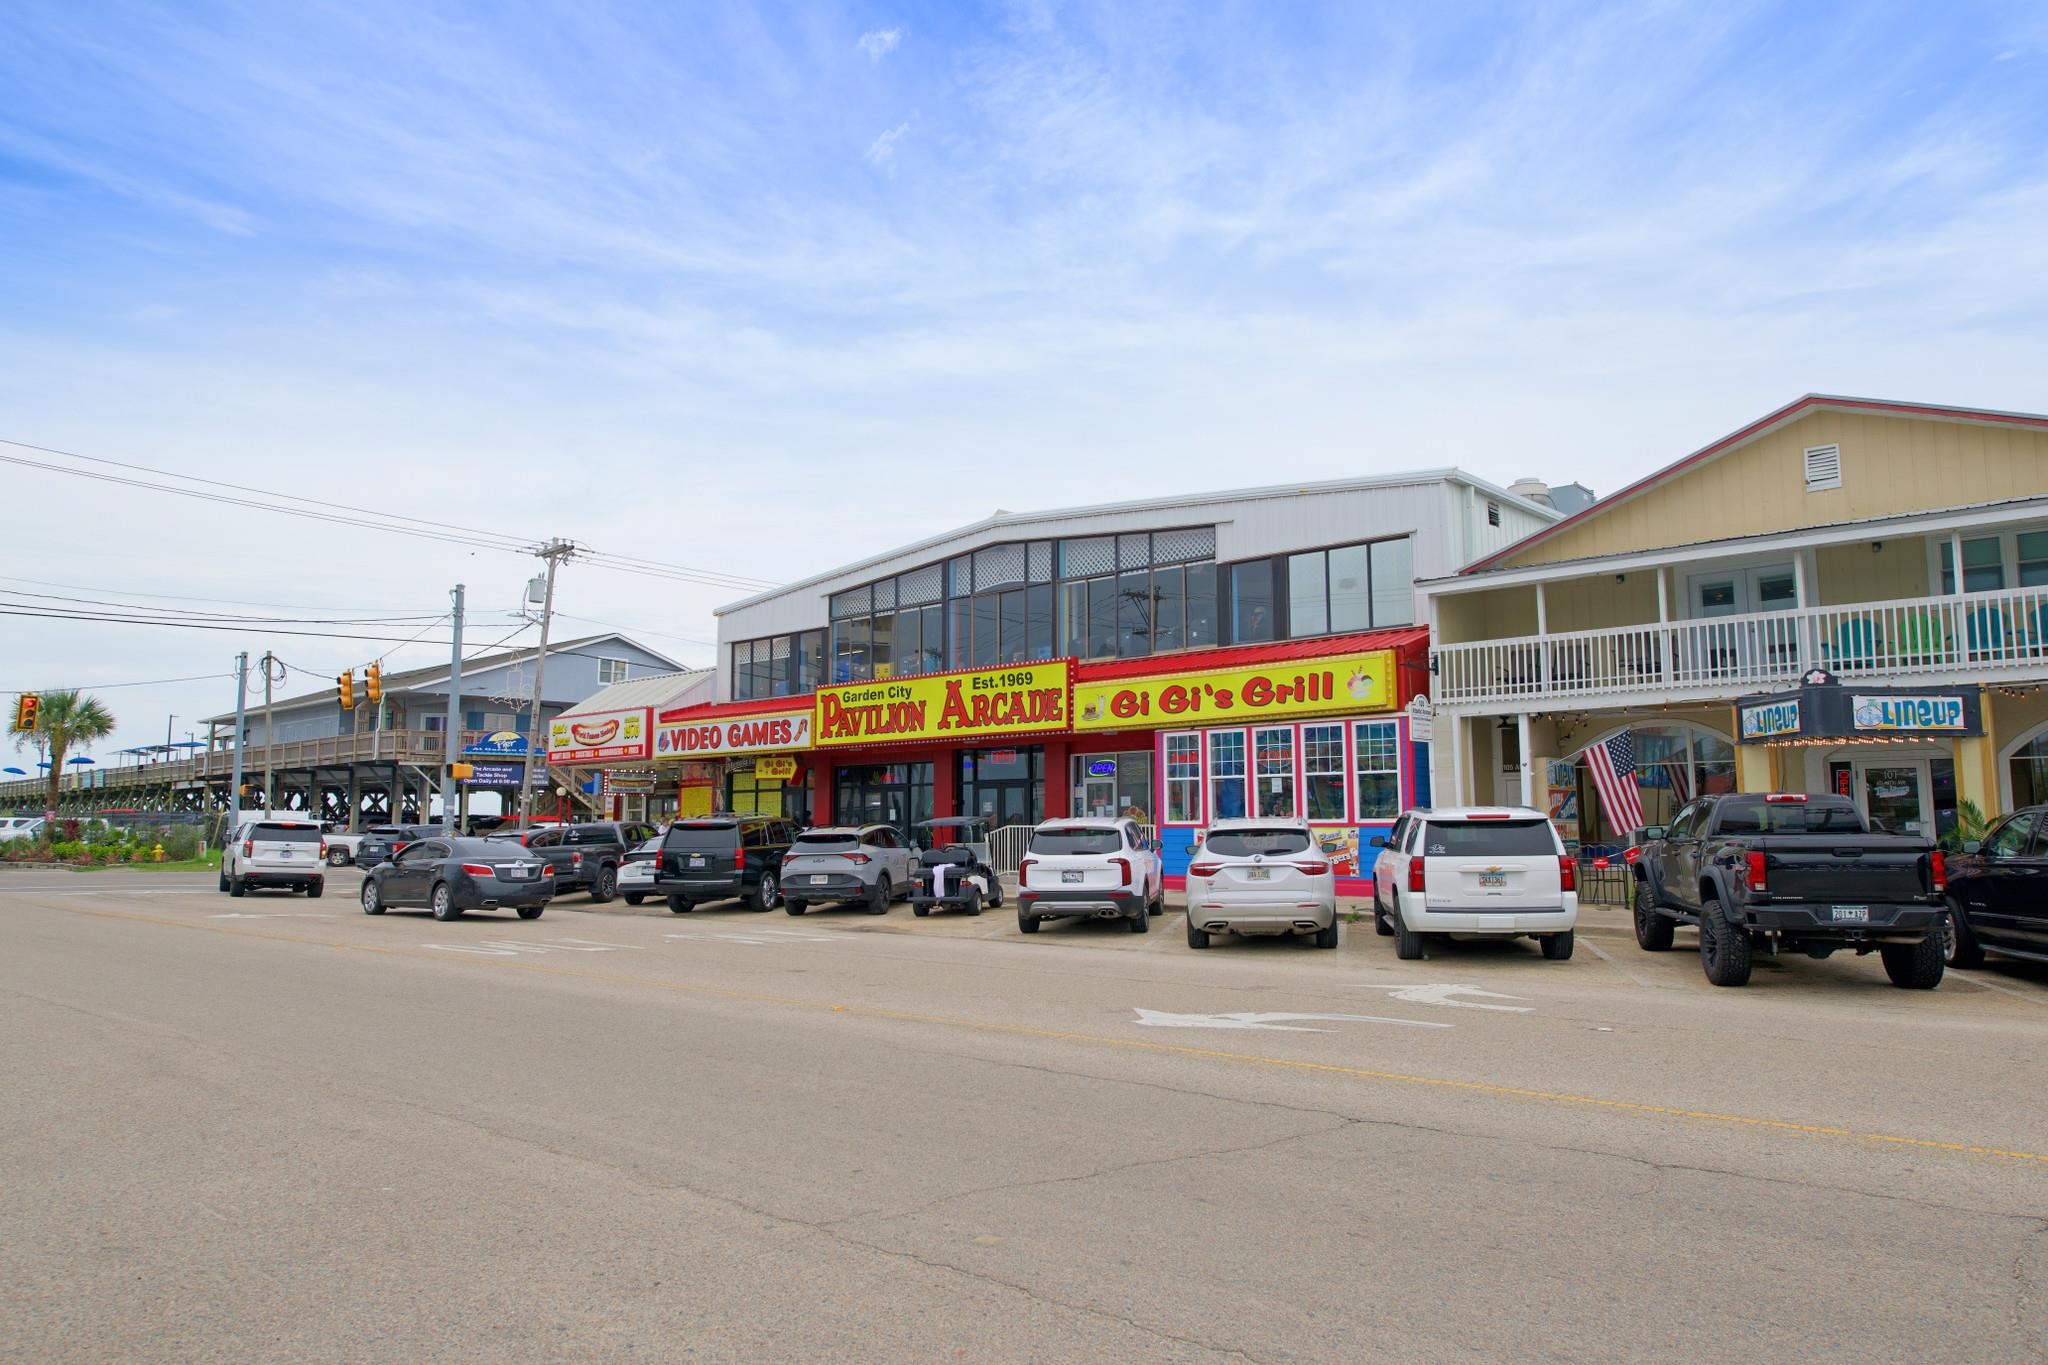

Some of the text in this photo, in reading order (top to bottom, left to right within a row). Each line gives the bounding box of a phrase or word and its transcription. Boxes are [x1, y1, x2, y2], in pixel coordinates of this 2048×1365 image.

[842, 685, 912, 703] Garden City
[1110, 671, 1334, 718] Gi Gi's Grill
[670, 719, 792, 751] VIDEO GAMES
[1090, 762, 1115, 774] OPEN
